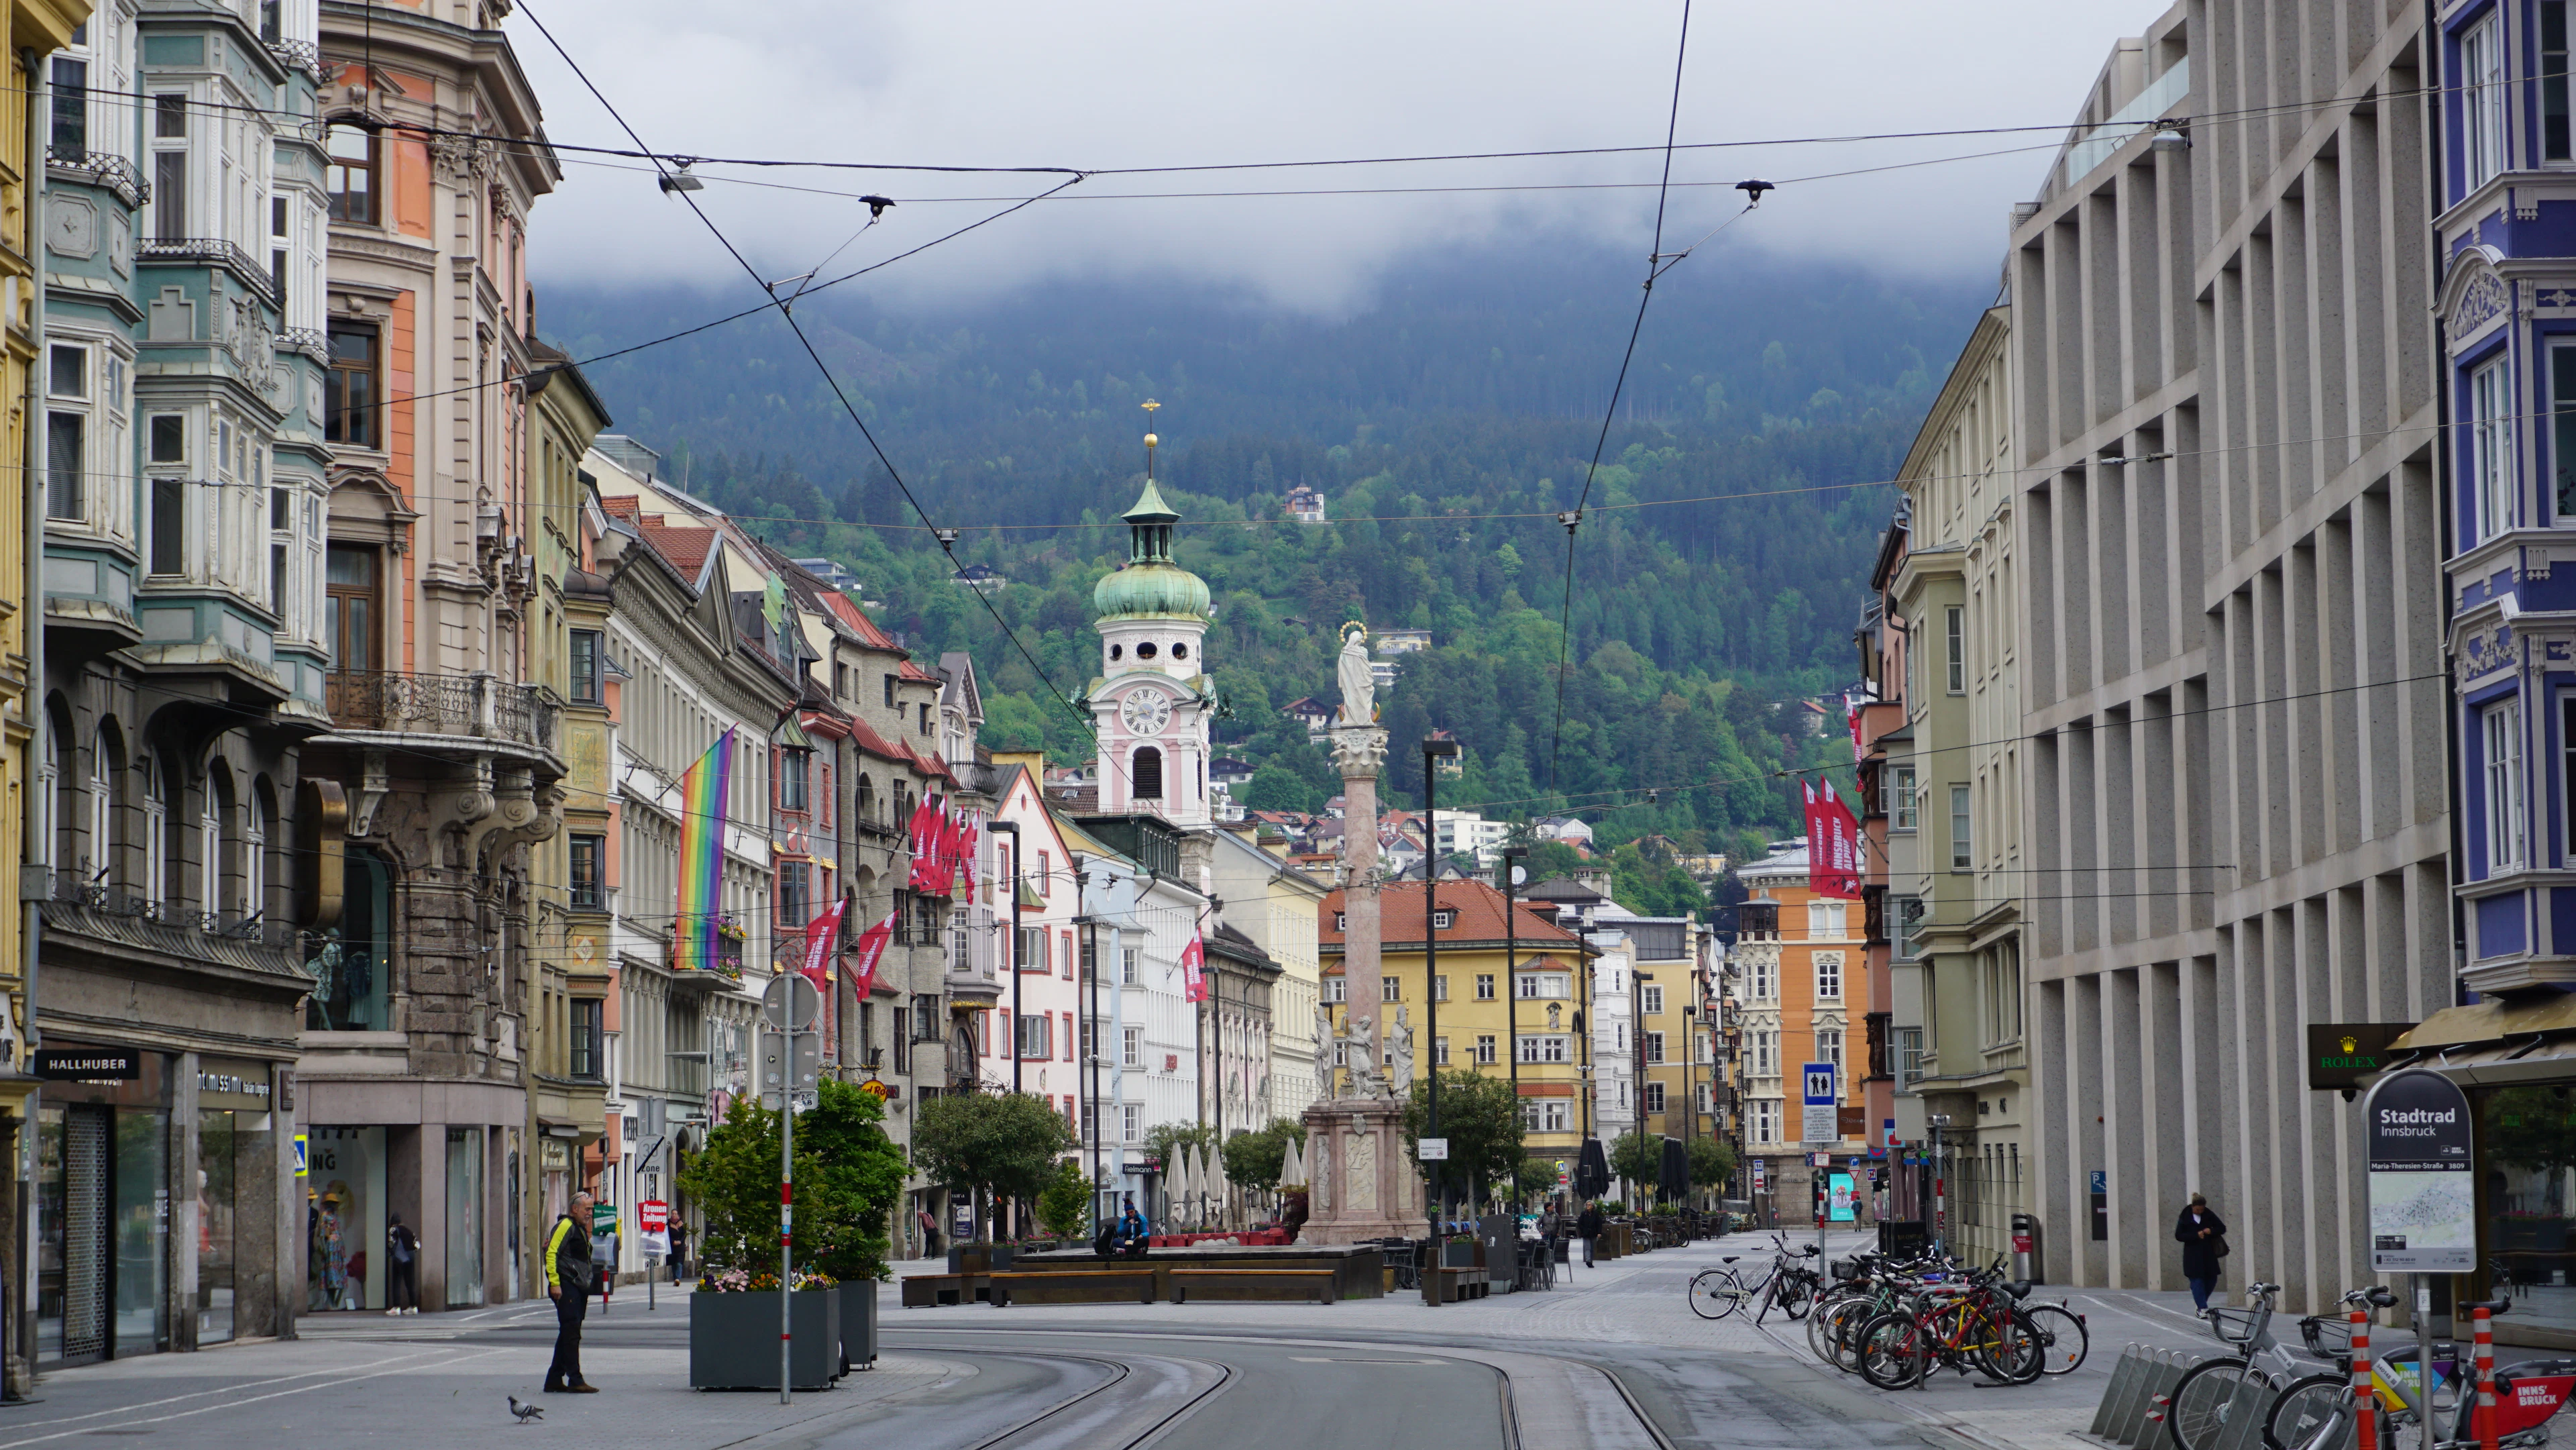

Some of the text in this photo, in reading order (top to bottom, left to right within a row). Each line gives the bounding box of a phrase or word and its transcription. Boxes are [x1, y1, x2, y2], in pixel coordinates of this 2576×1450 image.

[1833, 816, 1843, 870] INNSBRUCK
[49, 1059, 126, 1070] HALLHUBER
[2321, 1056, 2377, 1068] ROLEX
[197, 1070, 241, 1092] ntimissimi
[874, 1086, 896, 1098] Rock
[2381, 1107, 2455, 1123] Stadtrad
[2381, 1125, 2436, 1137] Innsbruck
[643, 1143, 658, 1157] 30
[641, 1164, 660, 1172] Zone
[643, 1203, 667, 1213] Kronen
[643, 1212, 667, 1224] Zeitung
[2376, 1363, 2392, 1380] 340148
[2518, 1385, 2548, 1396] INNS'
[2519, 1394, 2557, 1406] BRUCK
